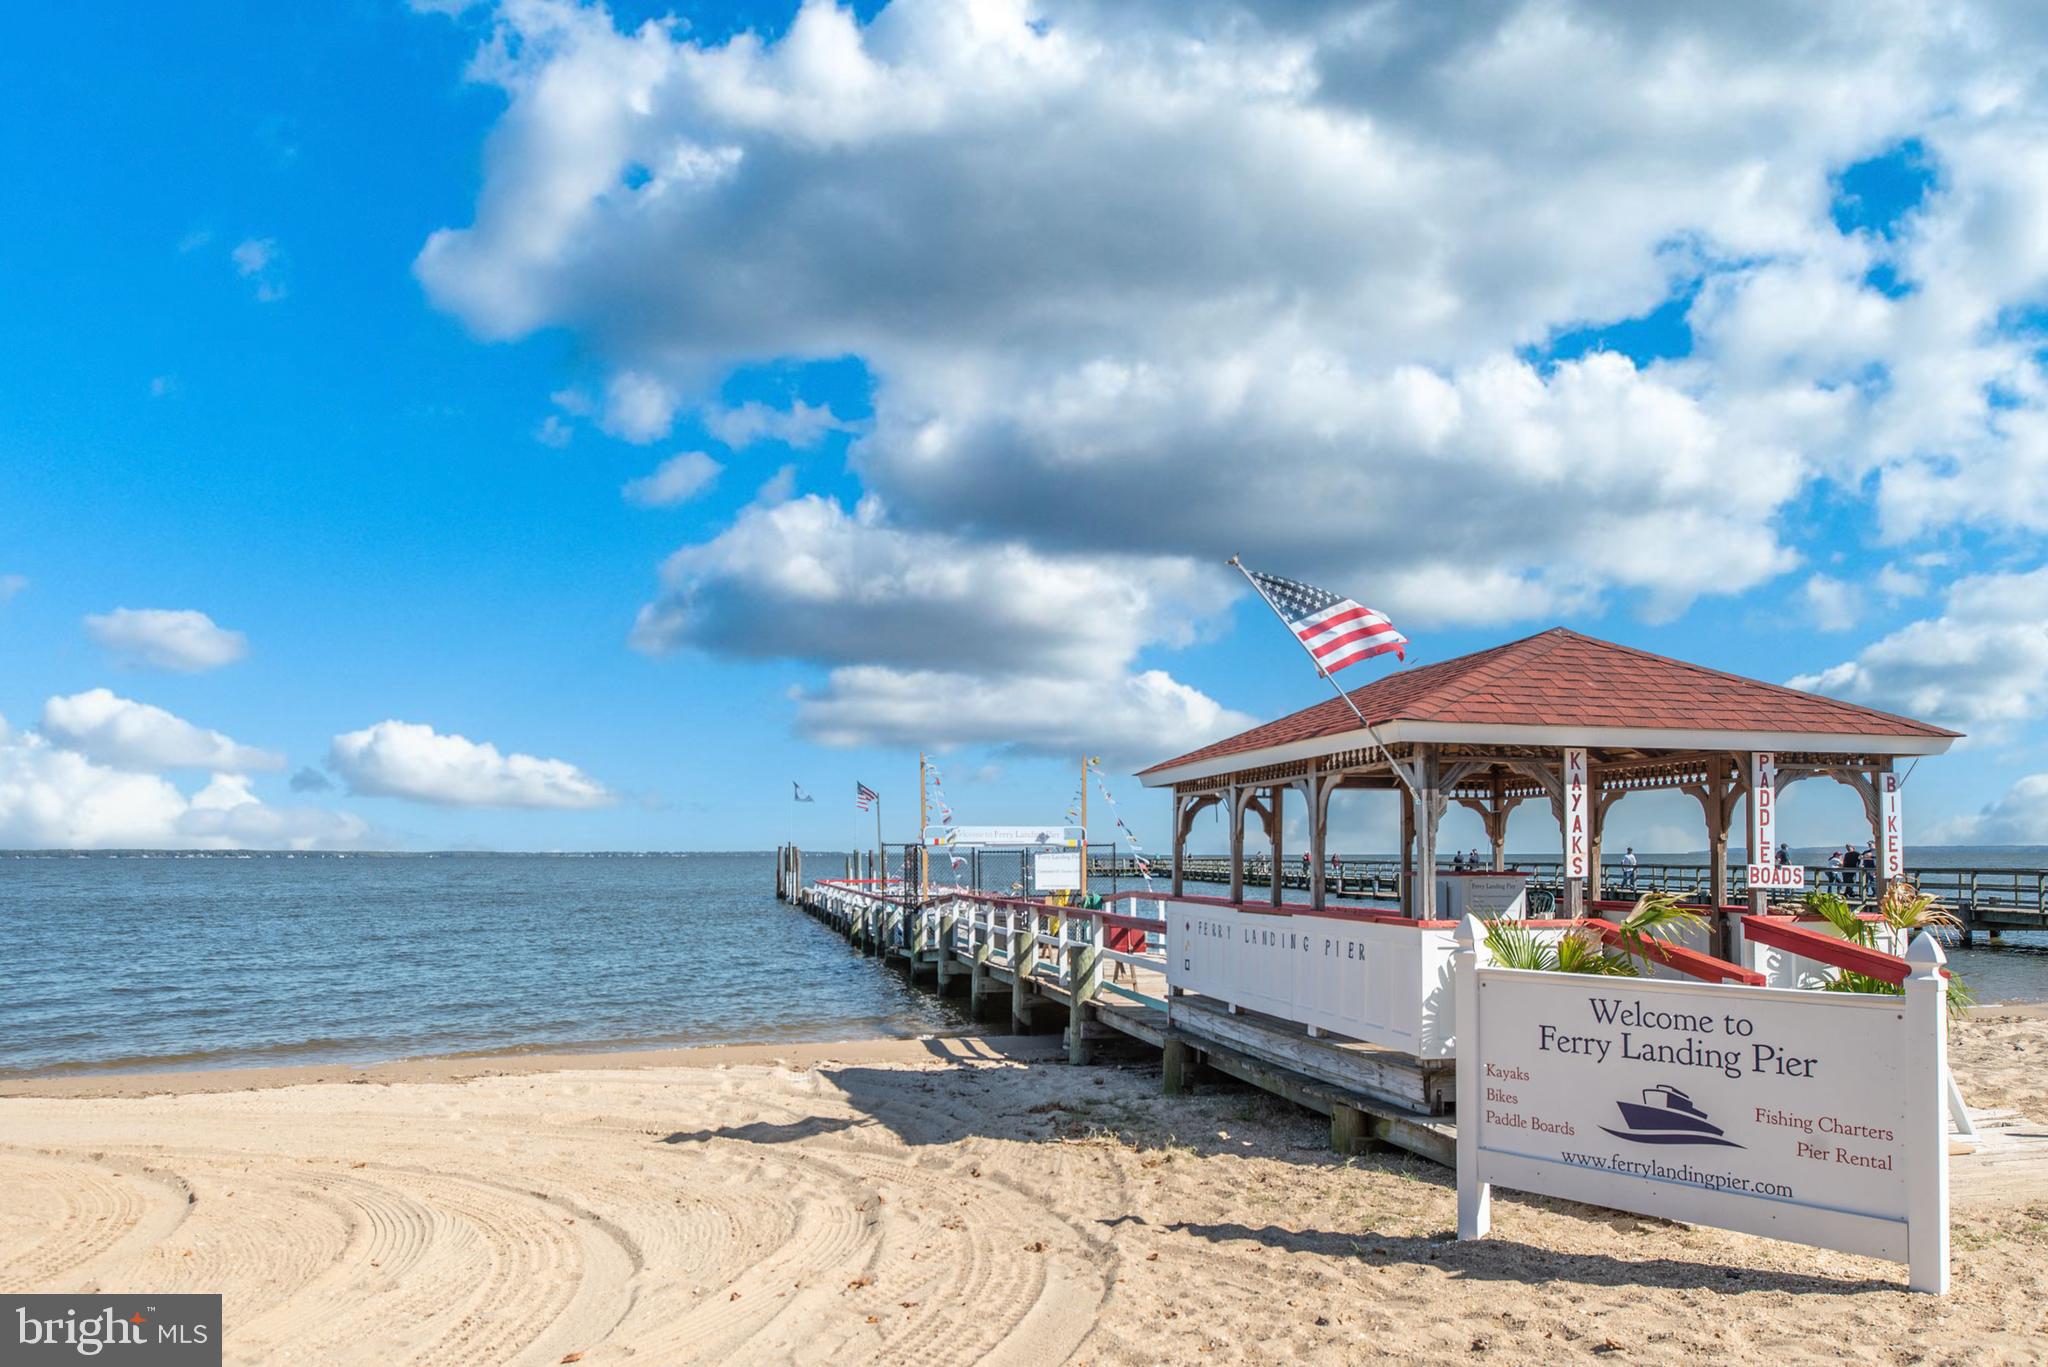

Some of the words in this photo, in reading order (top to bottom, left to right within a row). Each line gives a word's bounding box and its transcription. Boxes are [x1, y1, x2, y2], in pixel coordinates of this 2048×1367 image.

[1569, 751, 1582, 875] KAYAKS
[1759, 754, 1770, 864] PADDLE
[1886, 775, 1898, 872] BIKES
[1749, 866, 1803, 885] BOADS
[1198, 920, 1231, 940] FERRY
[1244, 928, 1309, 952] LANDING
[1325, 939, 1366, 961] PIER
[1588, 998, 1714, 1033] Welcome
[1723, 1014, 1753, 1037] to
[1538, 1024, 1612, 1063] Ferry
[1620, 1032, 1742, 1079] Landing
[1751, 1043, 1819, 1078] Pier
[1486, 1063, 1530, 1082] Kayaks
[1486, 1087, 1519, 1105] Bikes
[1486, 1110, 1527, 1129] Paddle
[1531, 1117, 1575, 1136] Boards
[1755, 1107, 1813, 1134] Fishing
[1818, 1116, 1894, 1142] Charters
[1561, 1151, 1793, 1198] www.ferrylandingpier.com
[1796, 1141, 1830, 1162] Pier
[1835, 1147, 1893, 1171] Rental
